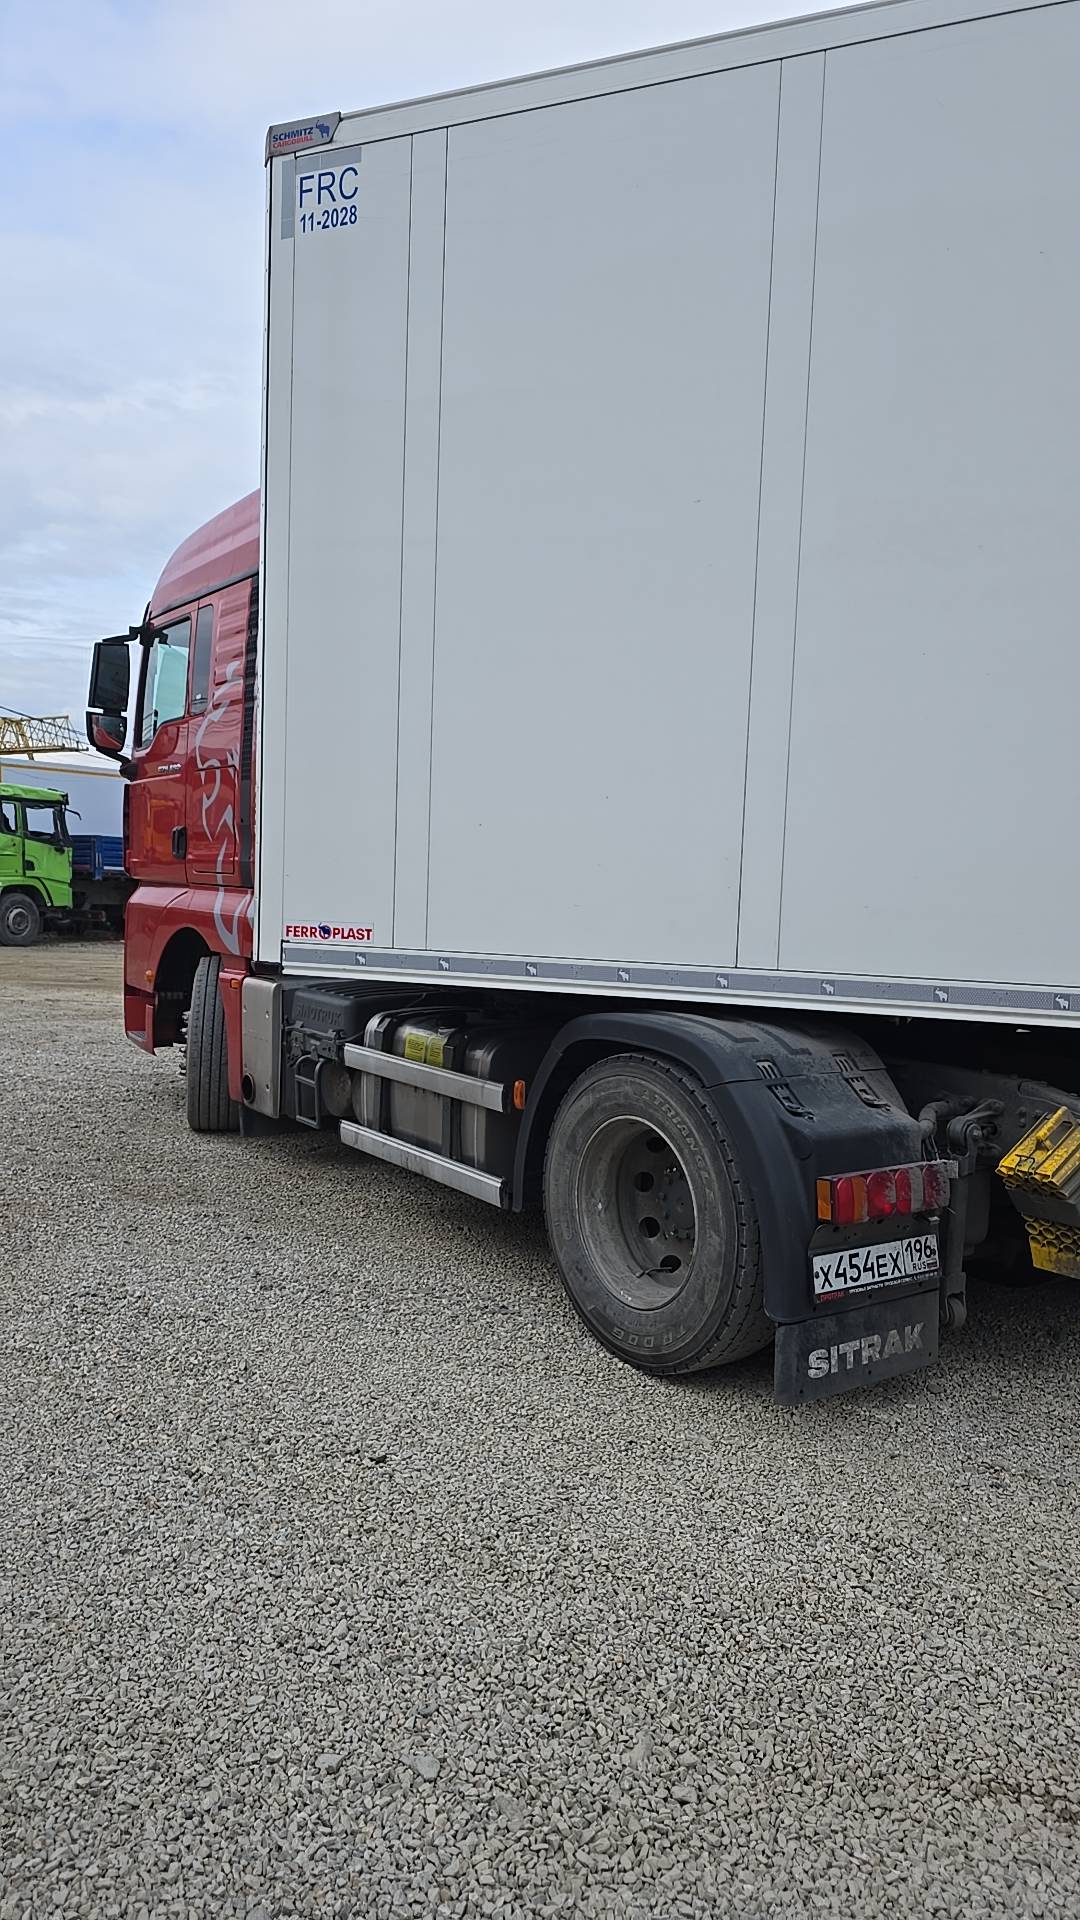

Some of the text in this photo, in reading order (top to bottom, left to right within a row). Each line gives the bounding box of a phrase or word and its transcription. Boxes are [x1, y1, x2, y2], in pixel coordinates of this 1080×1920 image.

[272, 127, 314, 142] SCHMITZ
[272, 135, 313, 149] CARGOBULL
[299, 166, 359, 209] FRC
[300, 205, 358, 233] 11-2028
[905, 1237, 932, 1263] 196
[912, 1260, 927, 1272] RUS
[807, 1322, 925, 1379] SITRAK
